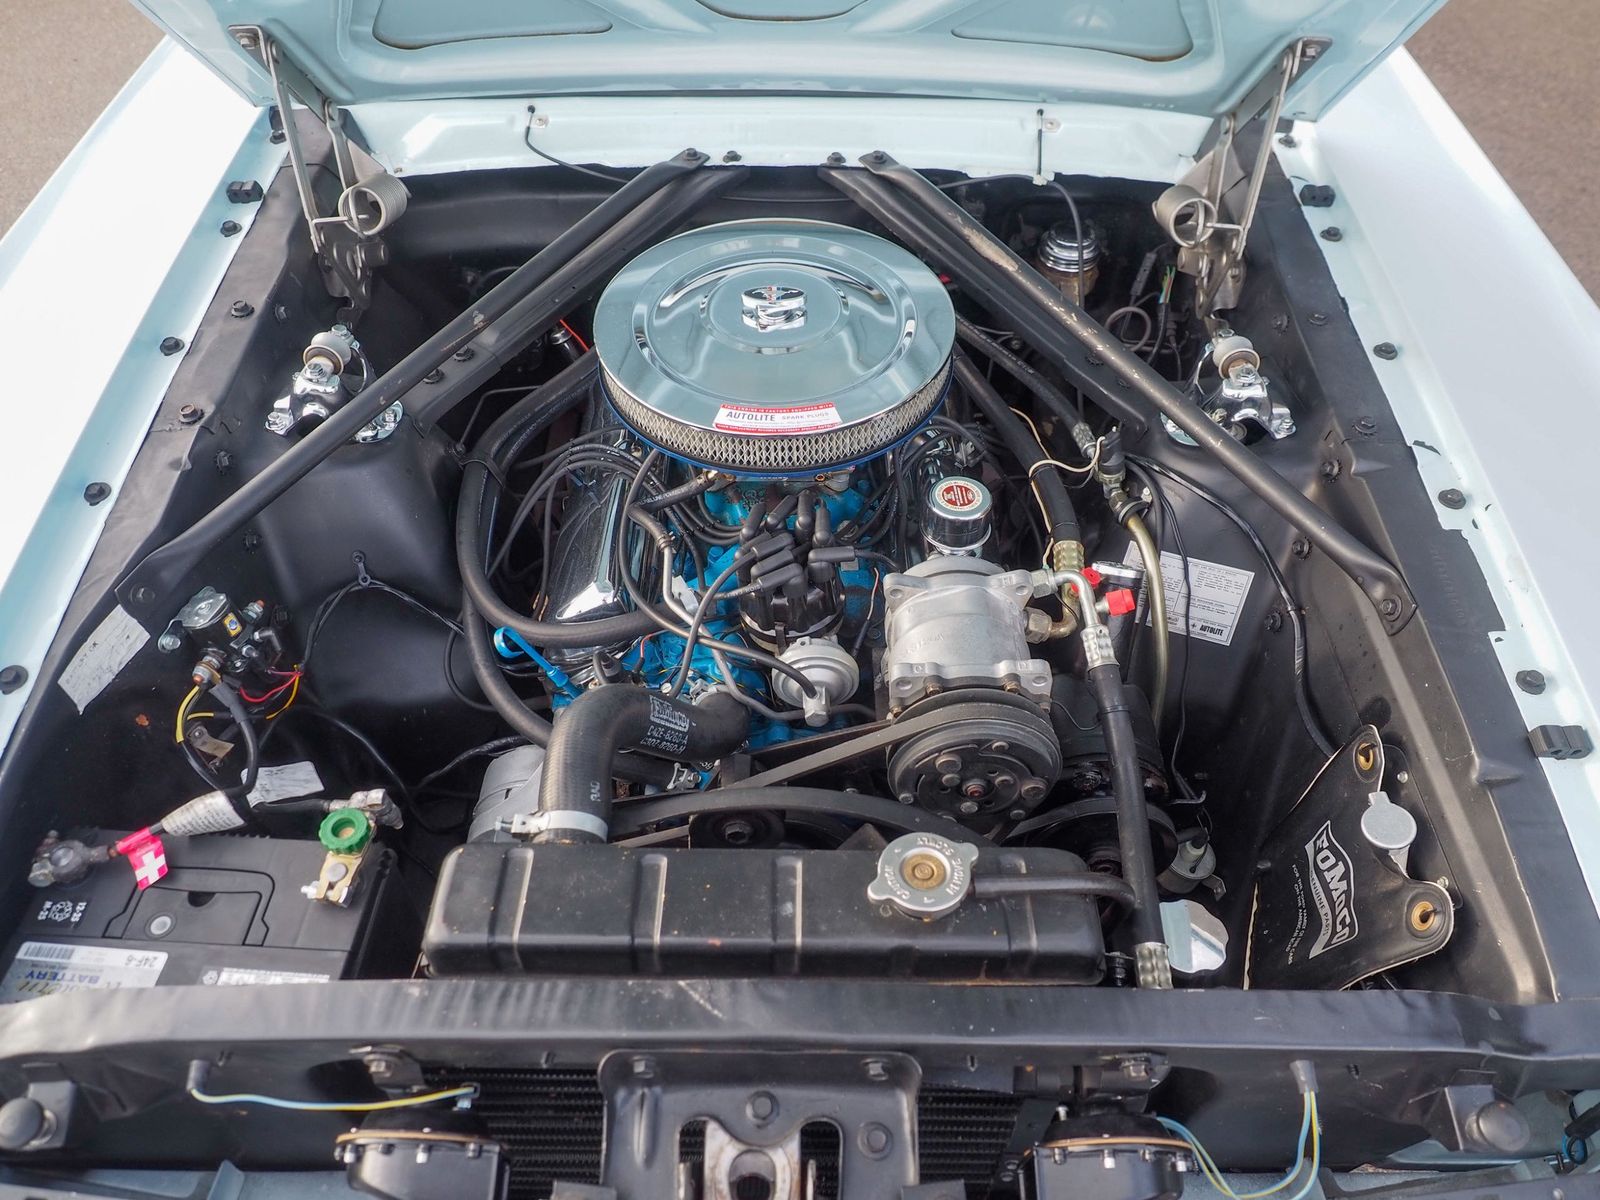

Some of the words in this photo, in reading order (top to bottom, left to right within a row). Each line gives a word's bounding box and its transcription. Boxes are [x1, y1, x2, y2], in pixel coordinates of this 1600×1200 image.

[726, 411, 776, 421] AUTOLITE
[1199, 624, 1224, 637] AUTOLITE
[1309, 870, 1326, 911] GENUINE
[125, 955, 158, 967] 24F-6
[25, 971, 100, 985] BATTERY
